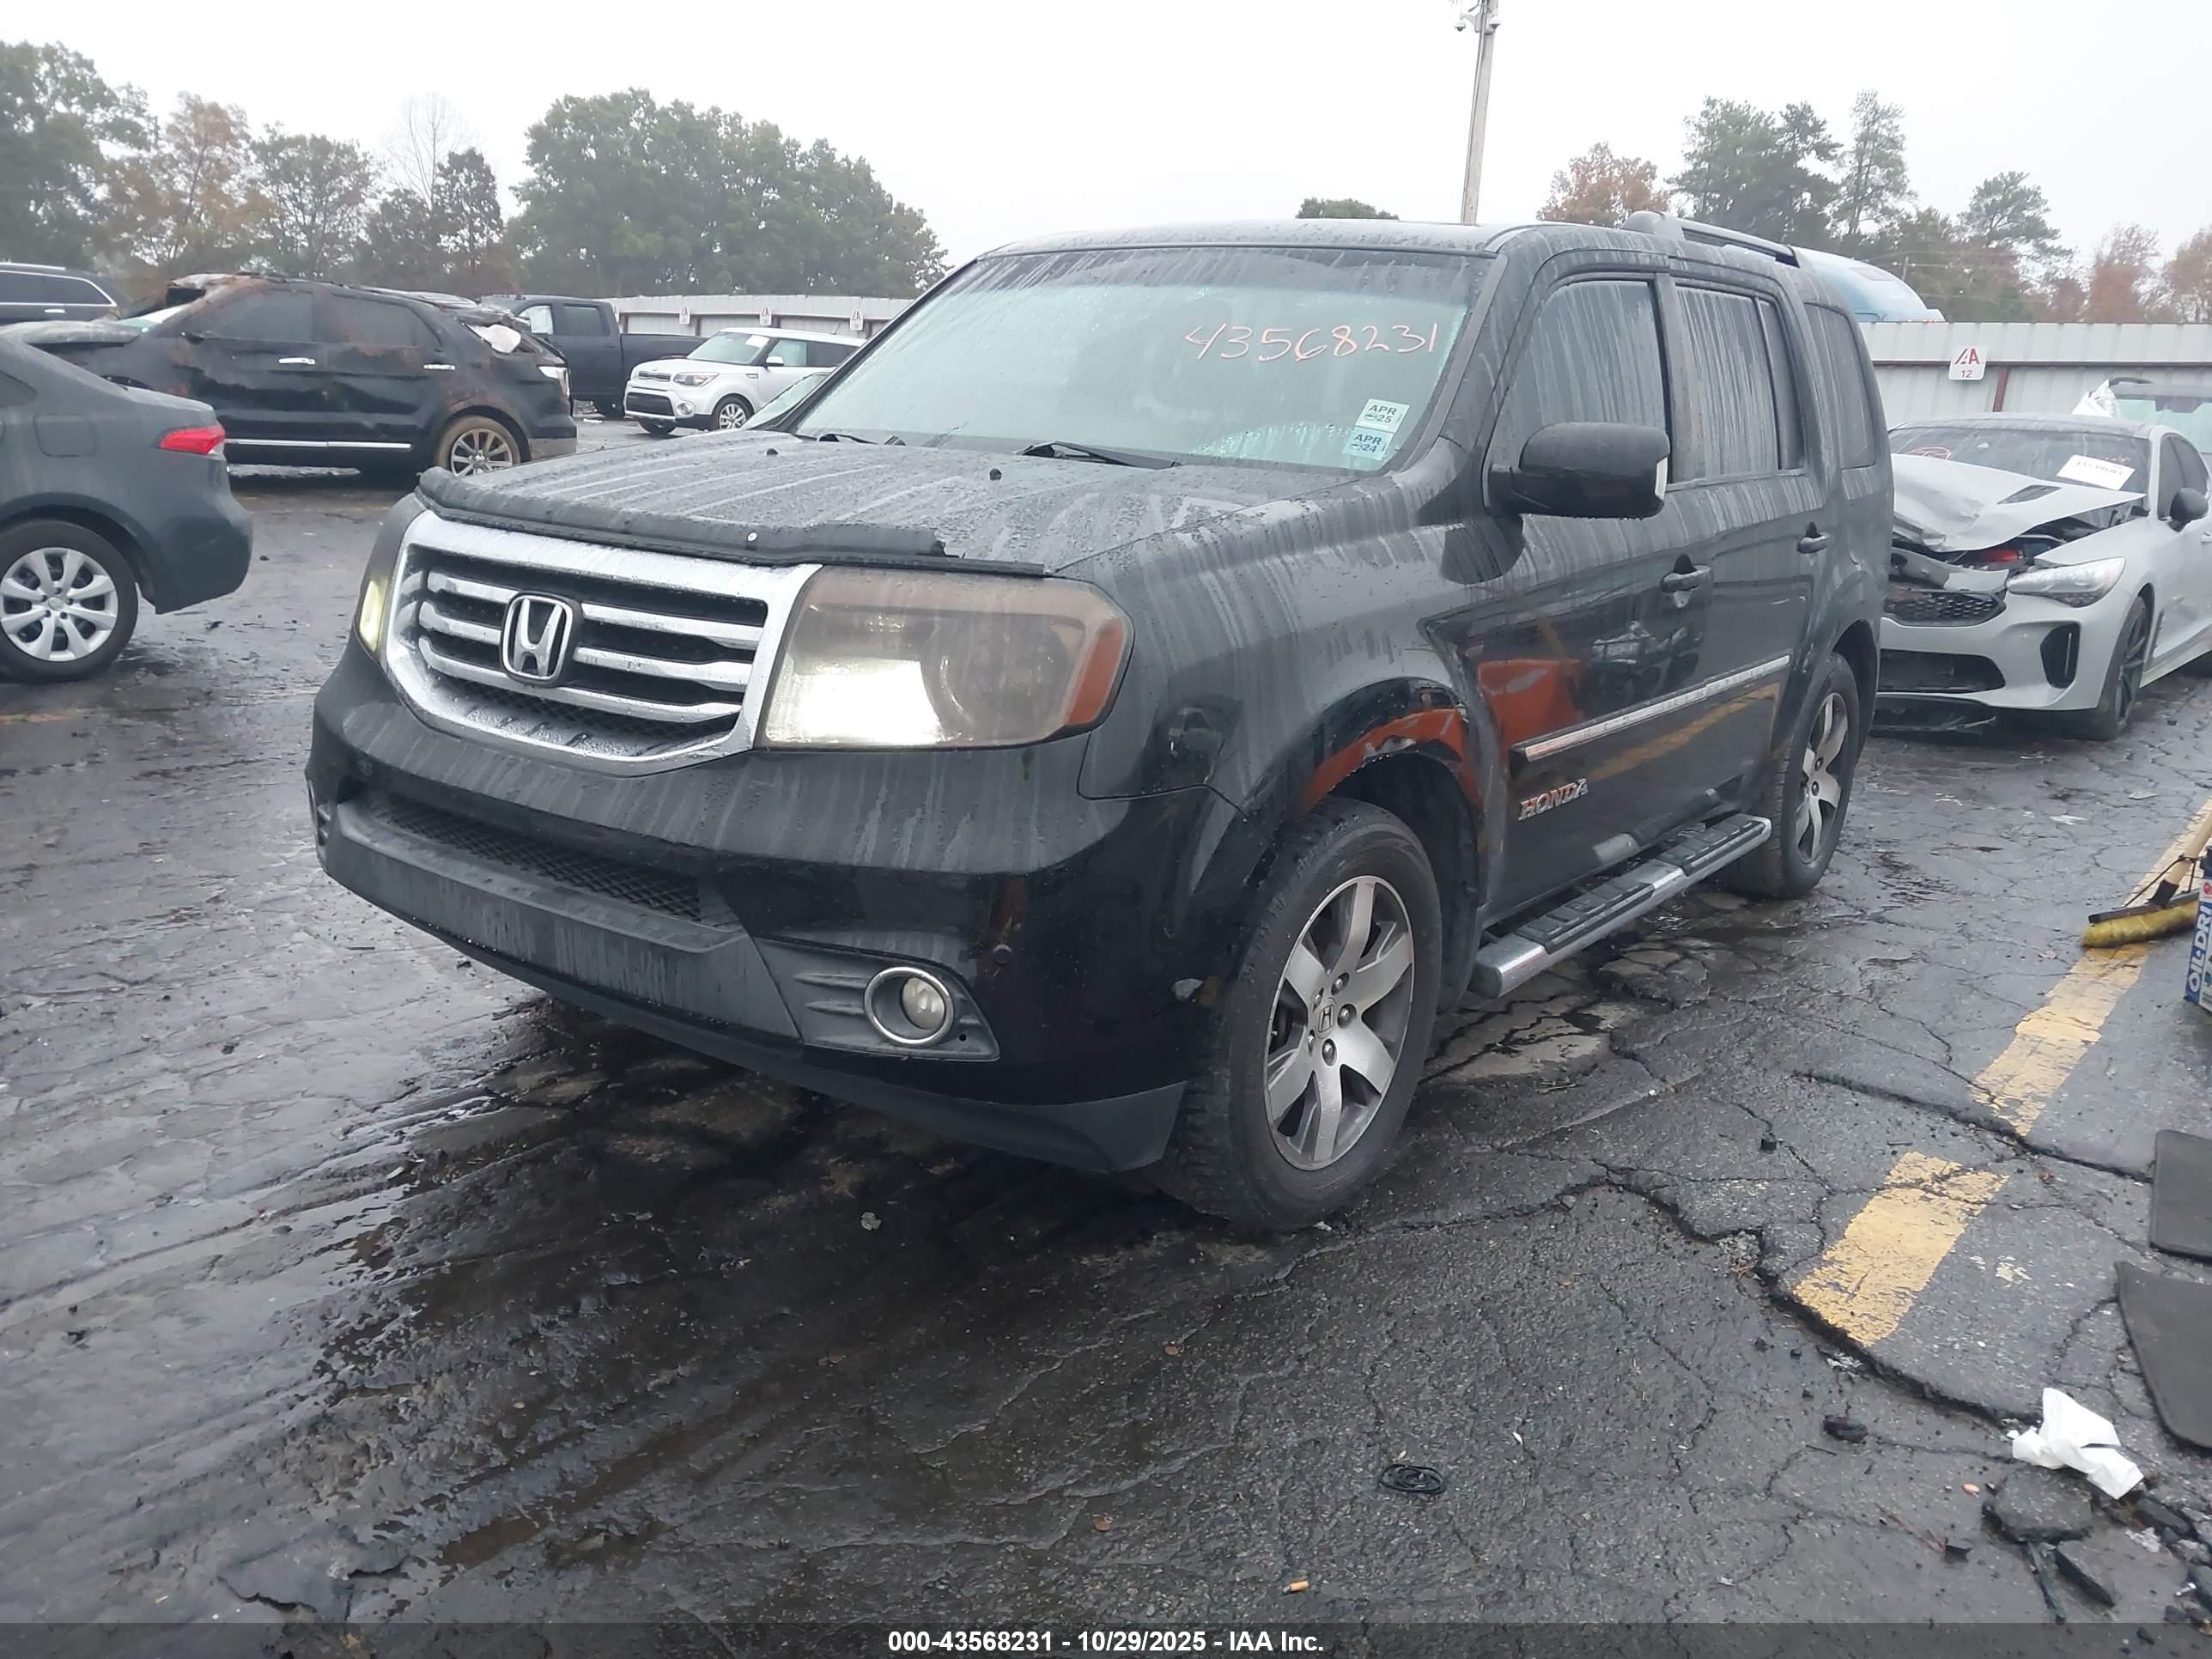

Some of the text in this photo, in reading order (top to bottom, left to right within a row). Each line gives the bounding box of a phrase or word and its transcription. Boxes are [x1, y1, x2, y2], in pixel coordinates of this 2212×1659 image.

[1184, 322, 1438, 362] 43568231
[1961, 369, 1972, 379] 12
[1368, 404, 1397, 416] APR
[1376, 414, 1394, 423] 25
[1353, 434, 1382, 446] APR
[1517, 777, 1589, 821] HONDA
